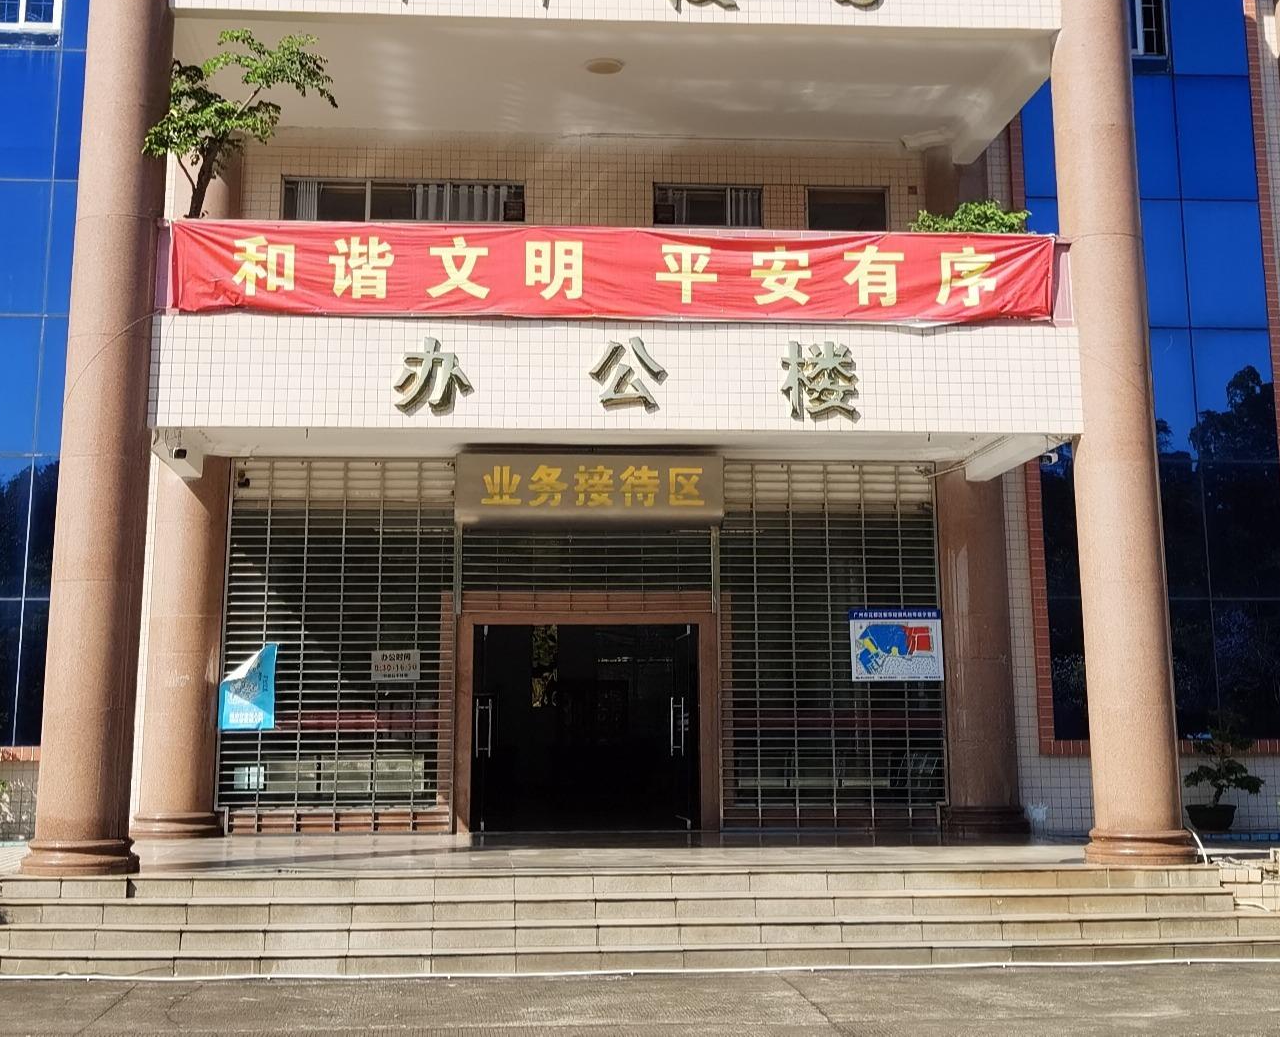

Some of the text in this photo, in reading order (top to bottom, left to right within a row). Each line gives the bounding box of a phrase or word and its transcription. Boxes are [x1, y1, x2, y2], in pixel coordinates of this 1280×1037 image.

[232, 234, 999, 308] 和谐文明 平安有序
[392, 335, 860, 421] 办公楼
[480, 464, 706, 507] 业务接待区
